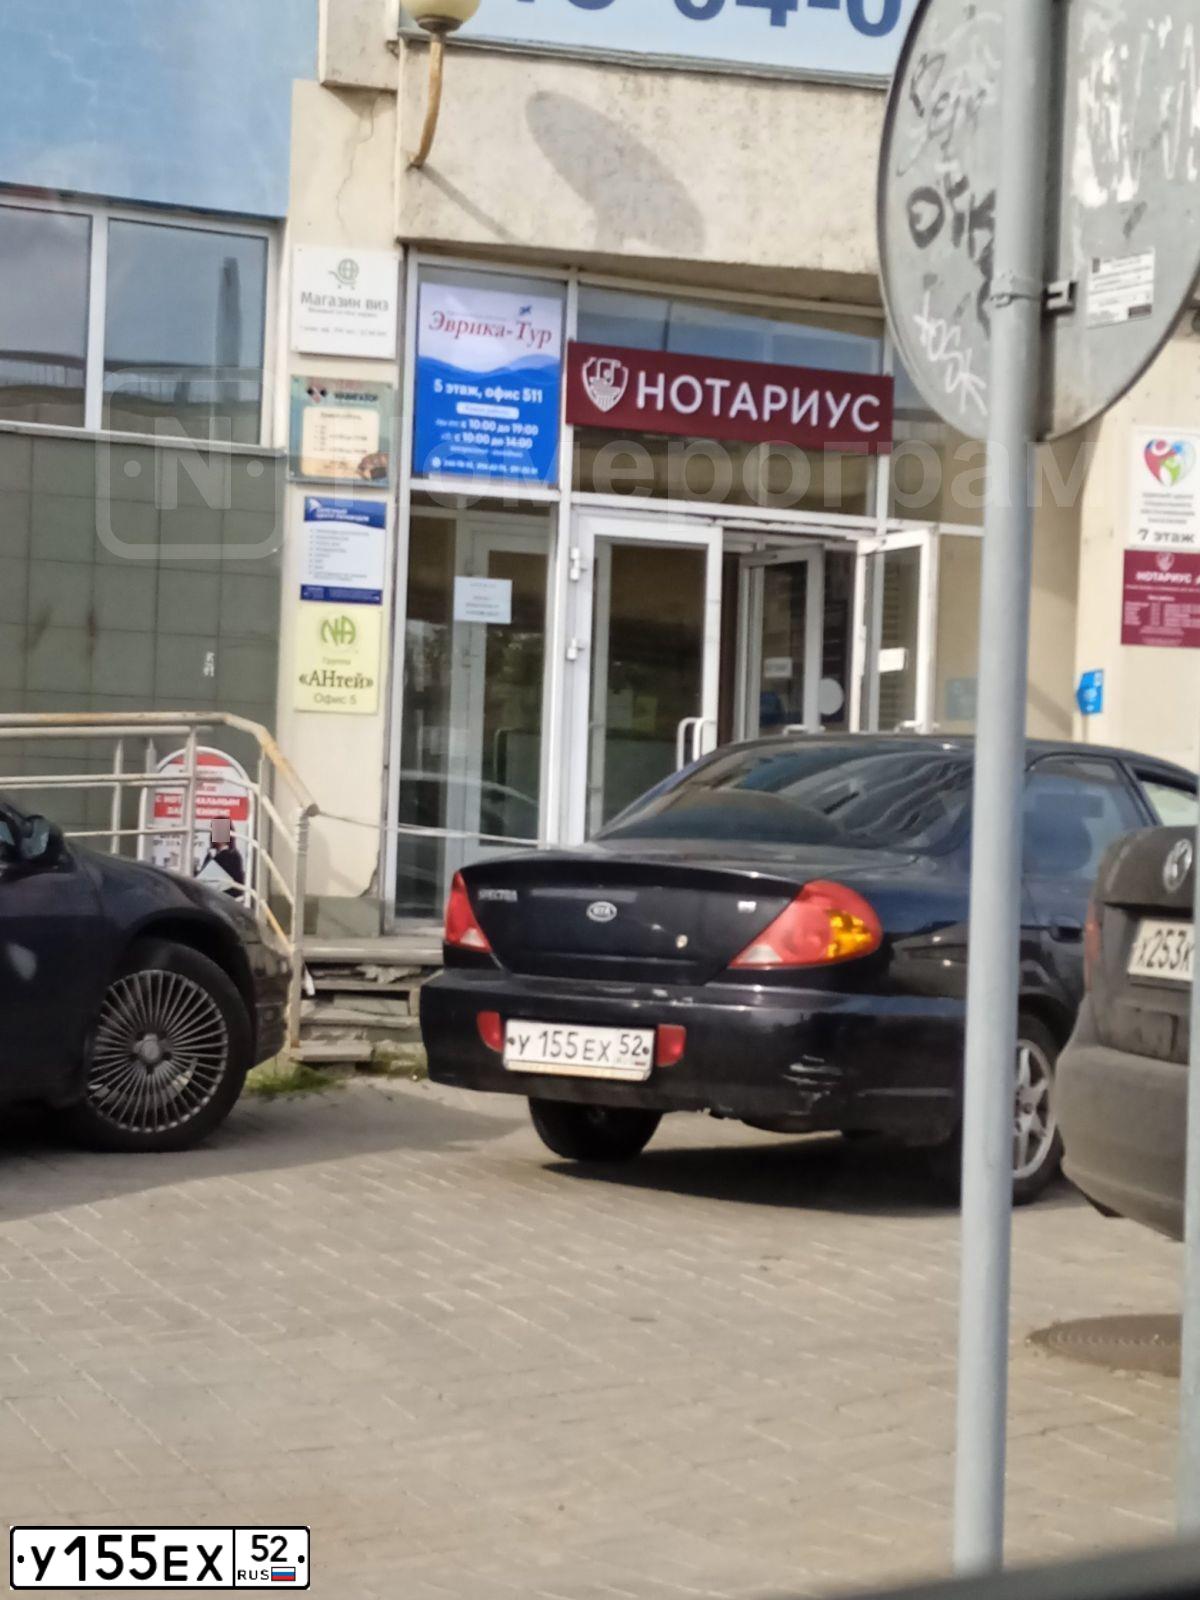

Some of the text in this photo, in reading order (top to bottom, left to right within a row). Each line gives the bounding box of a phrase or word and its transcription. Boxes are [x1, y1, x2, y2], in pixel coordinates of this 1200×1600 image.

[301, 291, 389, 311] Магазин виз
[428, 310, 552, 349] Эврика-Тур
[433, 378, 543, 403] 5 этаж, офис 511
[636, 370, 880, 432] НОТАРИУС
[1137, 528, 1195, 543] 7 этаж
[1136, 571, 1192, 584] НОТАРИУС
[299, 669, 374, 689] «АНтей»
[313, 692, 346, 706] Офис
